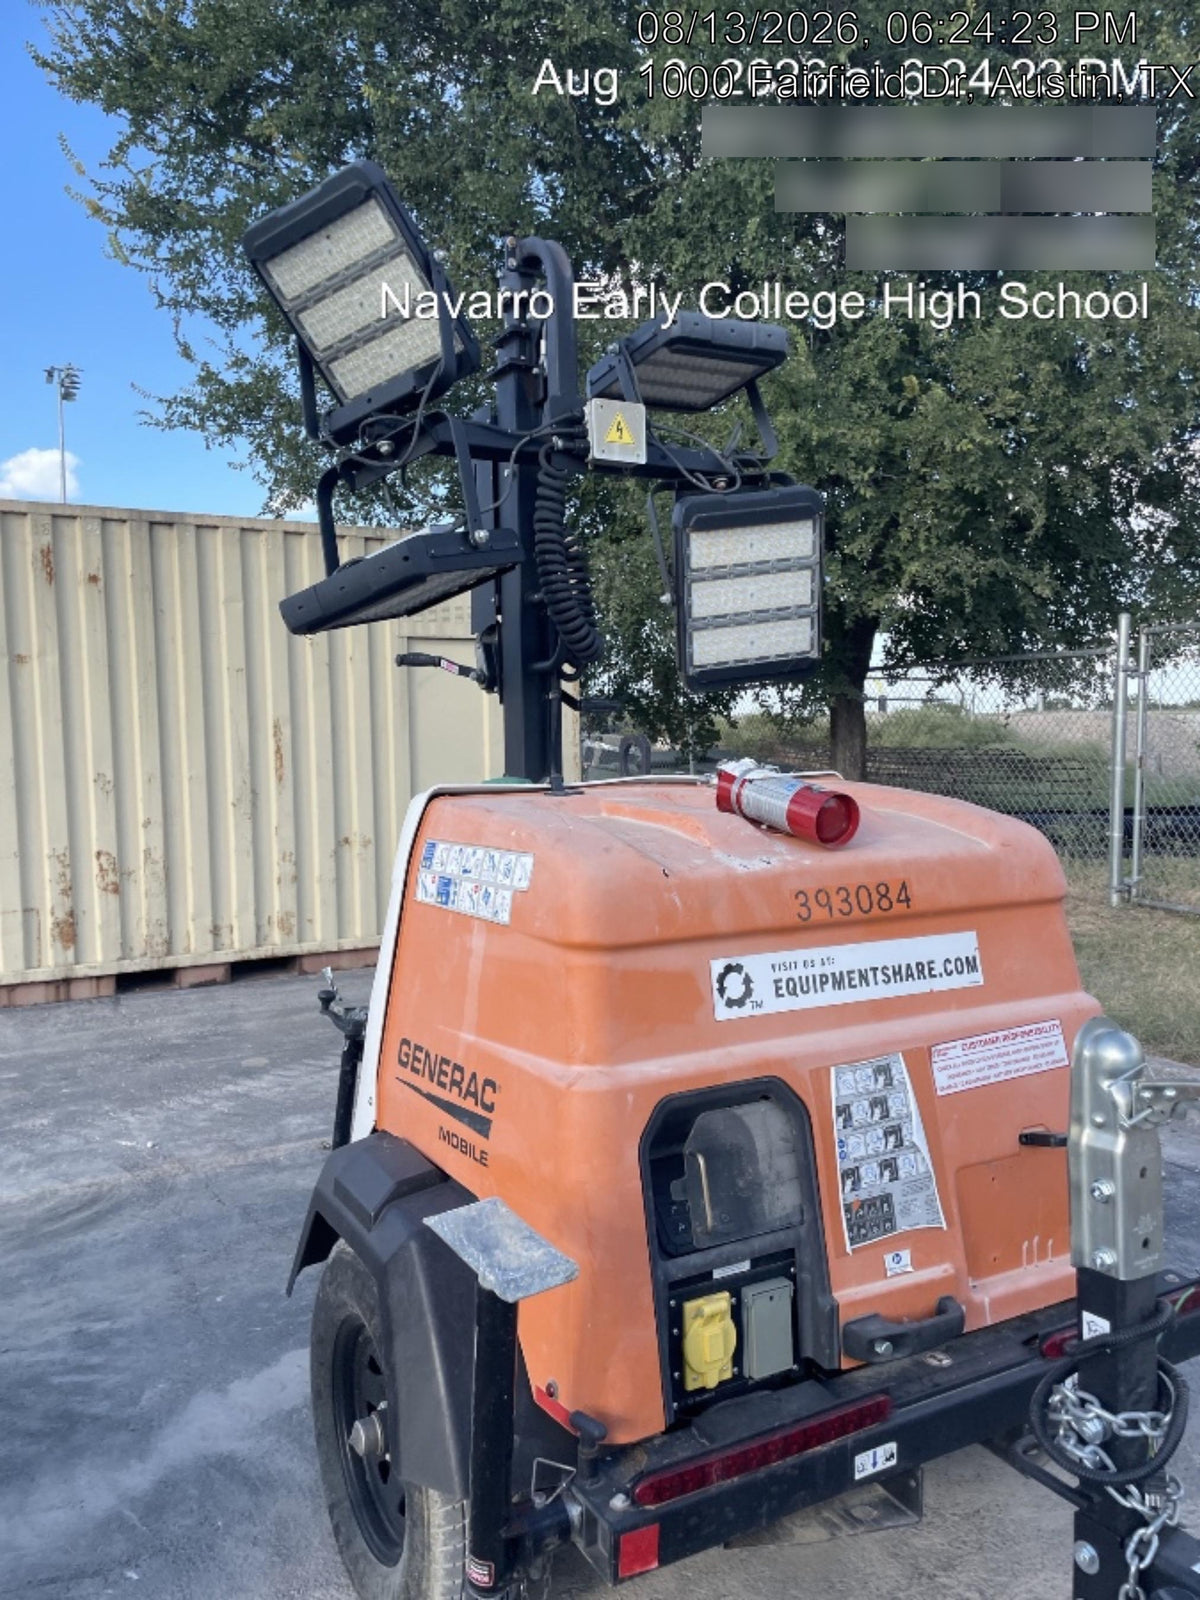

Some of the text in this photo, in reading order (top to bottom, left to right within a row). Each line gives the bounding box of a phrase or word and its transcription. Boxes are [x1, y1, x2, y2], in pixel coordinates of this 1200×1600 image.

[795, 880, 911, 921] 393084
[773, 955, 979, 998] EQUIPMENTSHARE.COM
[398, 1037, 497, 1114] GENERAC
[438, 1125, 489, 1168] MOBILE
